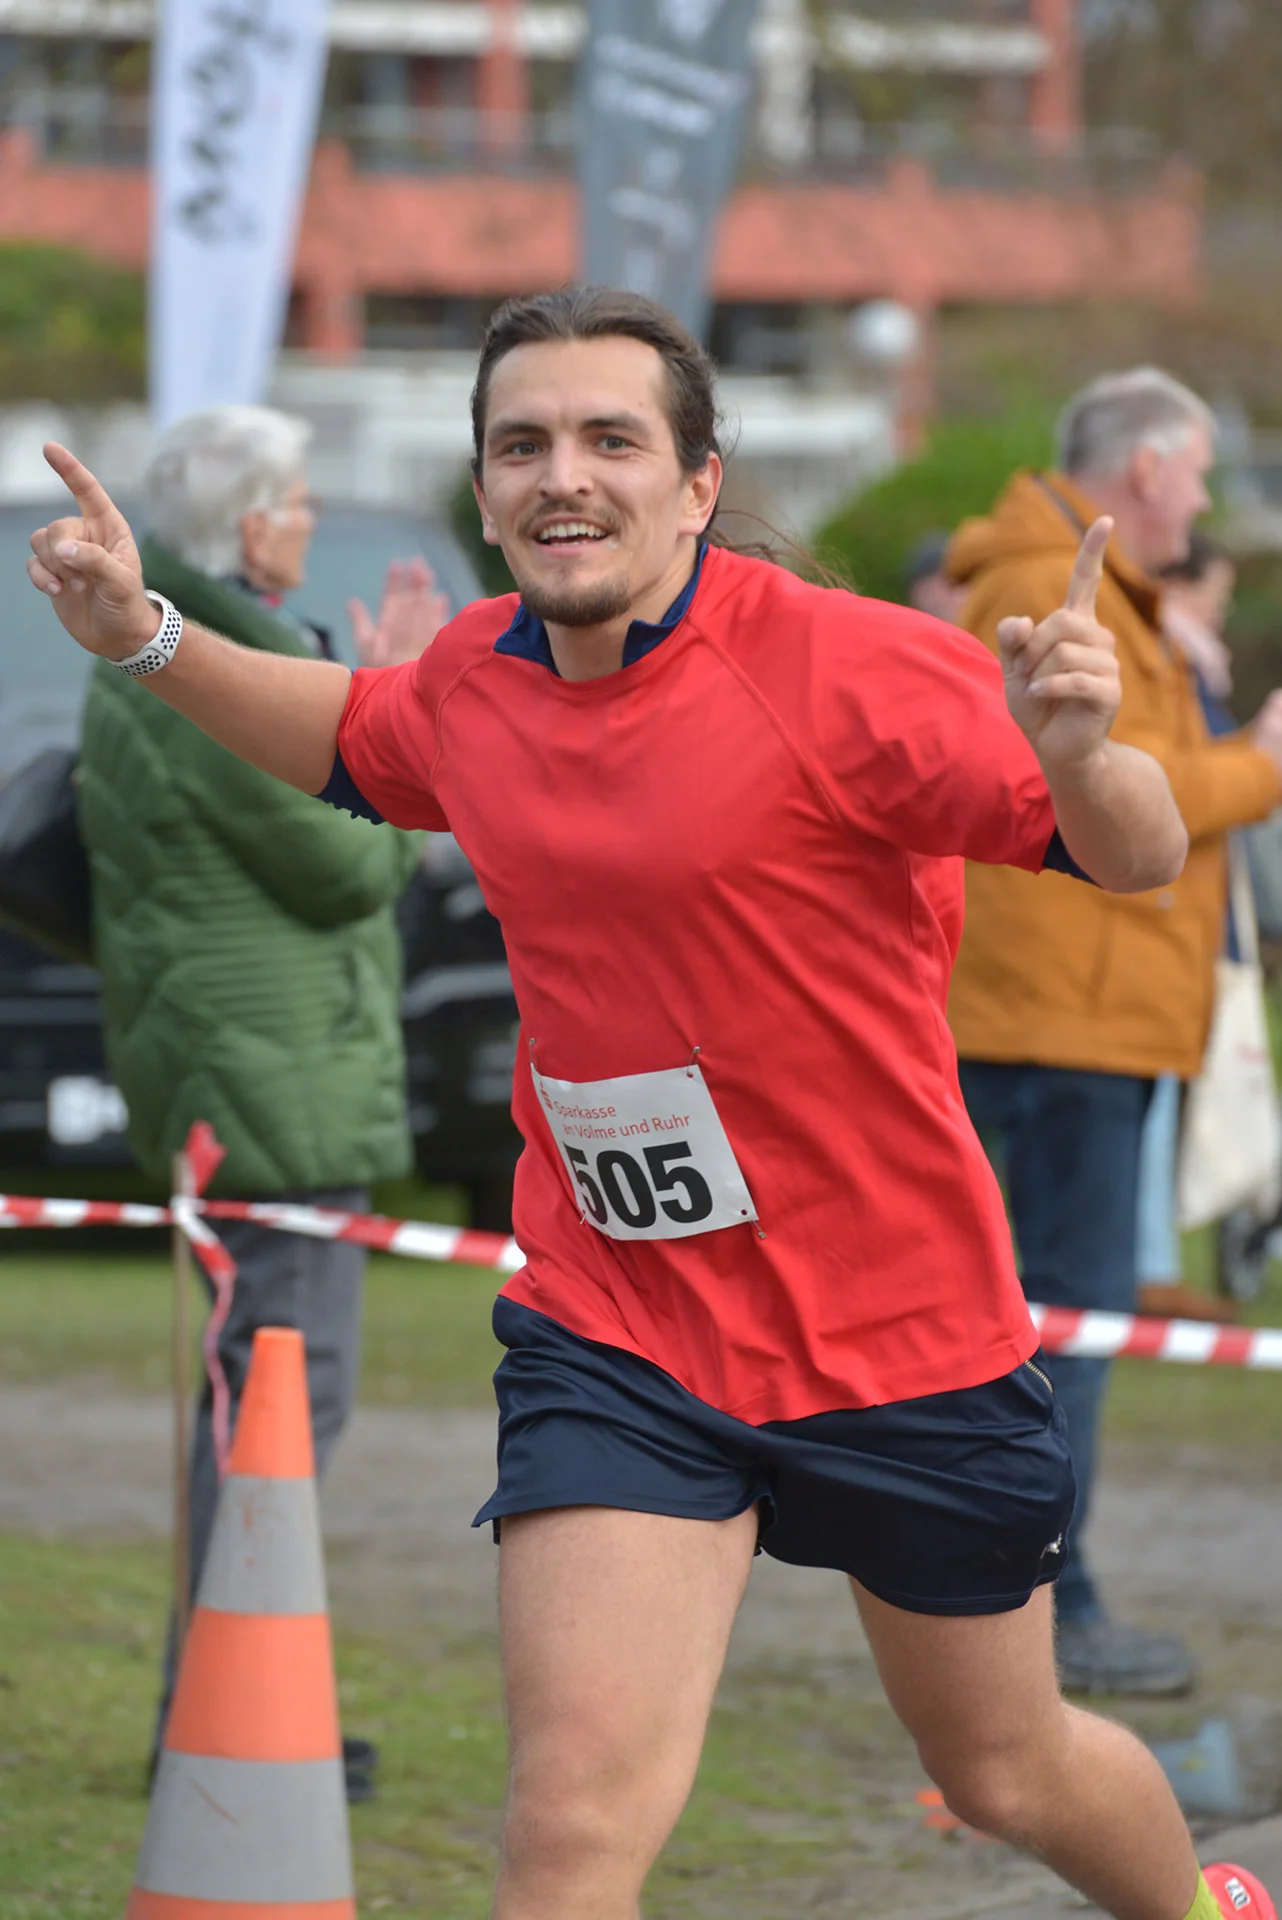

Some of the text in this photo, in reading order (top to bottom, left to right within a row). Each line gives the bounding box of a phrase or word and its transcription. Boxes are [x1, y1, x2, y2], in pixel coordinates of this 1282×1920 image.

[555, 1102, 616, 1120] Sparkasse
[563, 1115, 690, 1139] an Volme und Ruhr
[563, 1141, 713, 1228] 505
